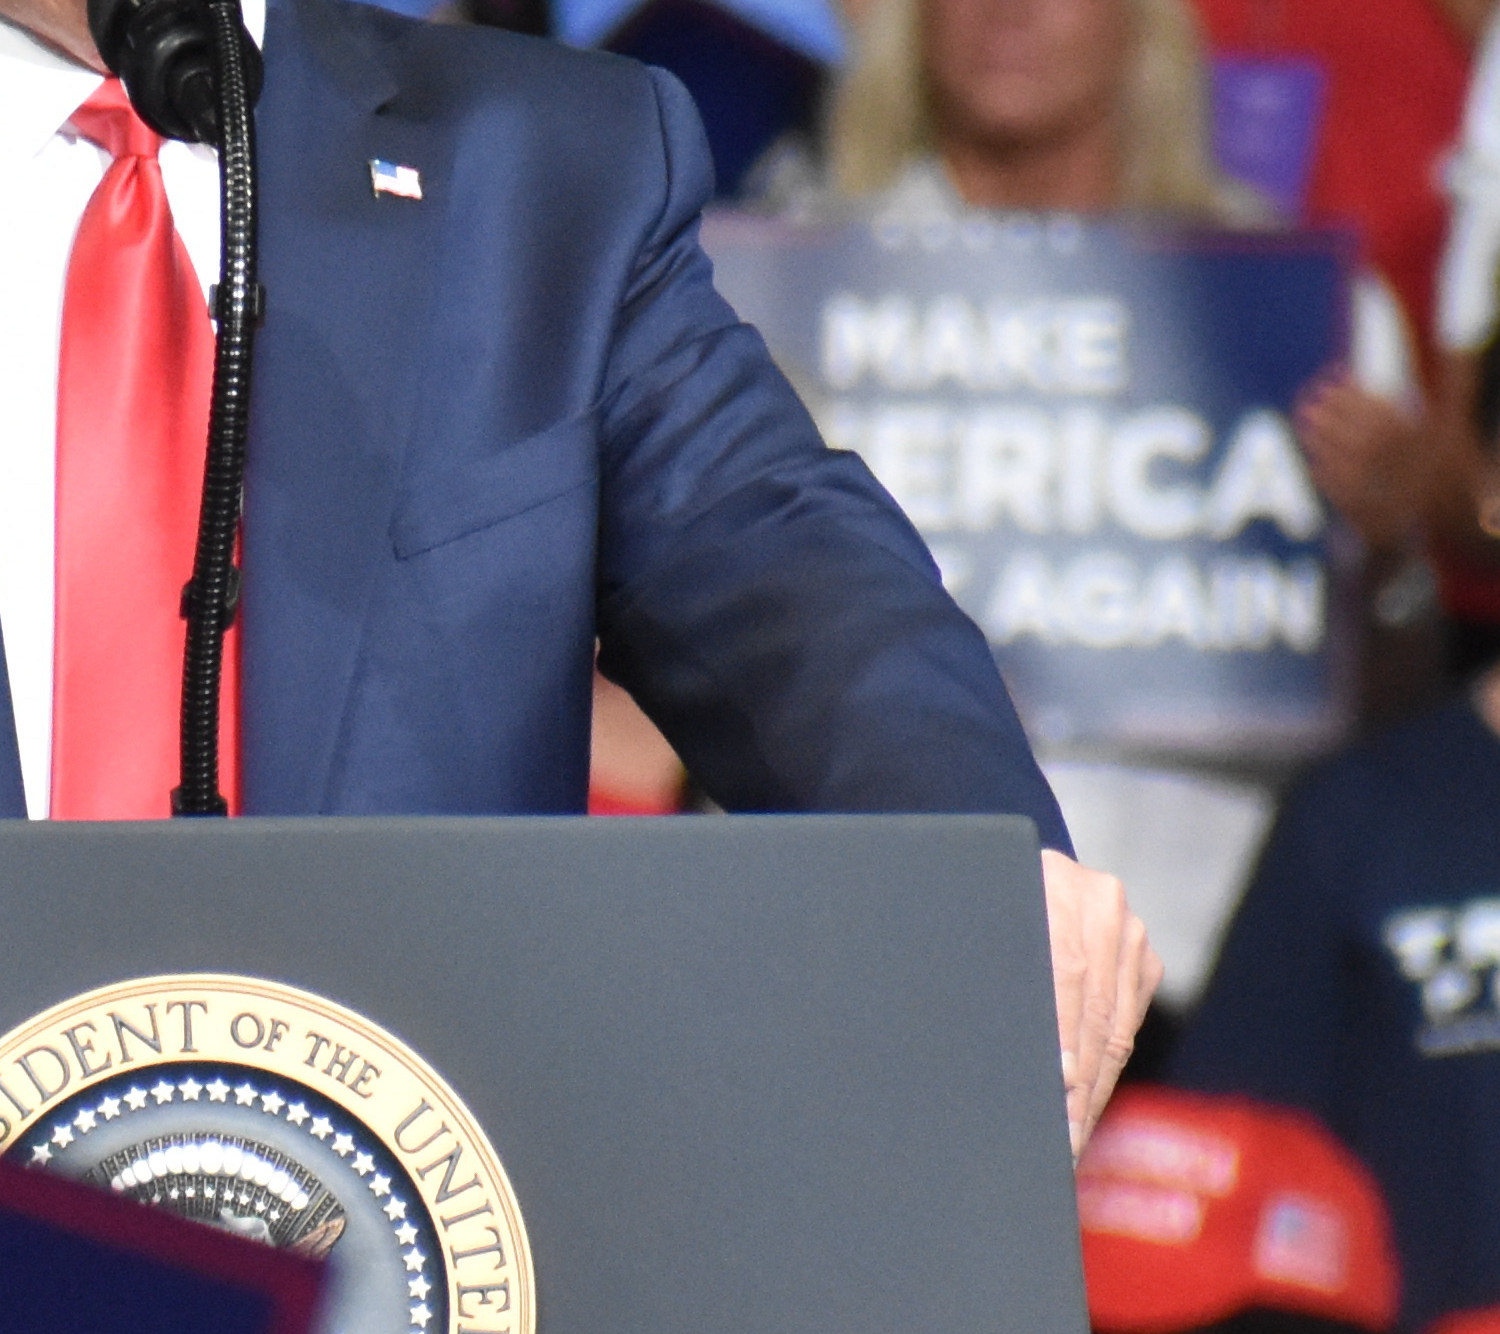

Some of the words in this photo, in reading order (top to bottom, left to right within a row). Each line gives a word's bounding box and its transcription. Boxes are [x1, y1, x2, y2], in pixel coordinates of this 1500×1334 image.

[821, 291, 1133, 395] MAKE
[829, 404, 1327, 544] ERICA
[990, 547, 1327, 654] AGAIN
[229, 1012, 293, 1053] OF
[304, 1029, 383, 1100] THE
